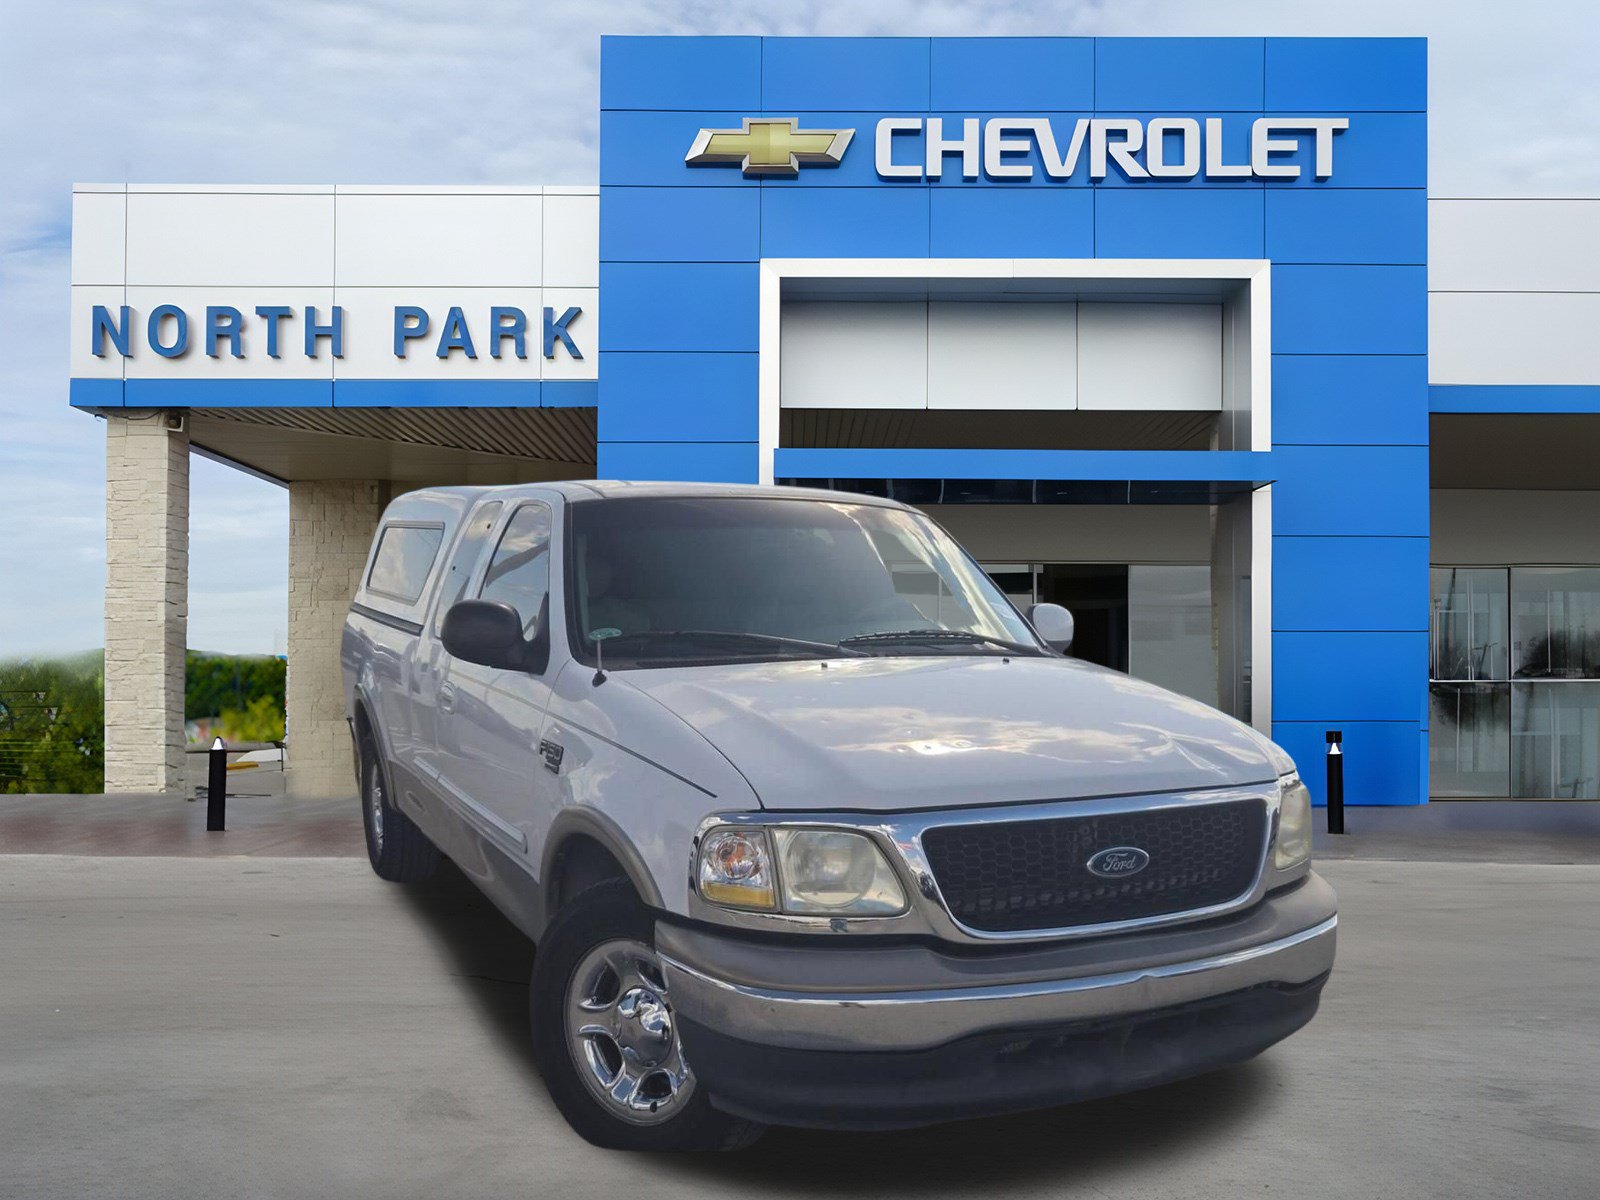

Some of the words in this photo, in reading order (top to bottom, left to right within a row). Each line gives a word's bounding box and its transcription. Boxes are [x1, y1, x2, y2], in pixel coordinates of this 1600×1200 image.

[875, 117, 1350, 180] CHEVROLET
[92, 304, 345, 359] NORTH
[394, 305, 585, 359] PARK
[1102, 852, 1136, 871] Ford
